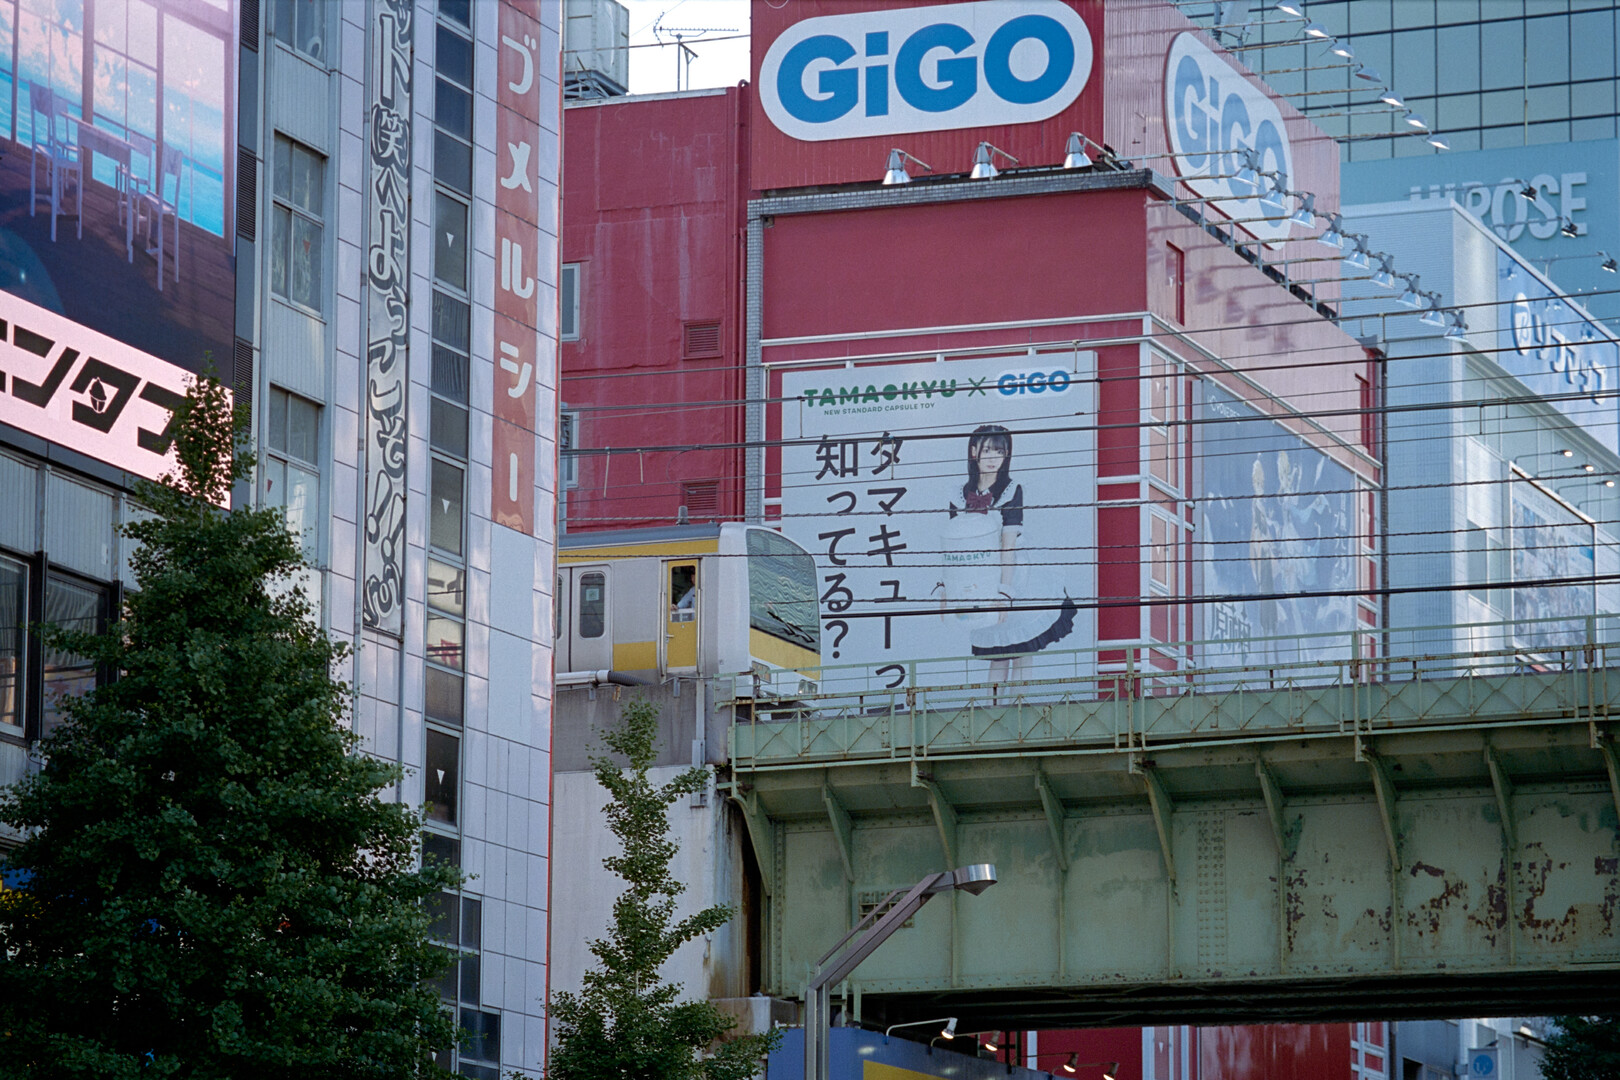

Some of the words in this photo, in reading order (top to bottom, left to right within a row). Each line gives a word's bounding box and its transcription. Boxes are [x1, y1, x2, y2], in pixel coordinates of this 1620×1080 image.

[777, 14, 1075, 124] GiGO
[1174, 55, 1287, 228] GiGO
[1410, 172, 1588, 243] ROSE
[842, 406, 883, 415] STANDARD
[884, 403, 918, 412] CAPSULE
[997, 370, 1071, 396] GiGO
